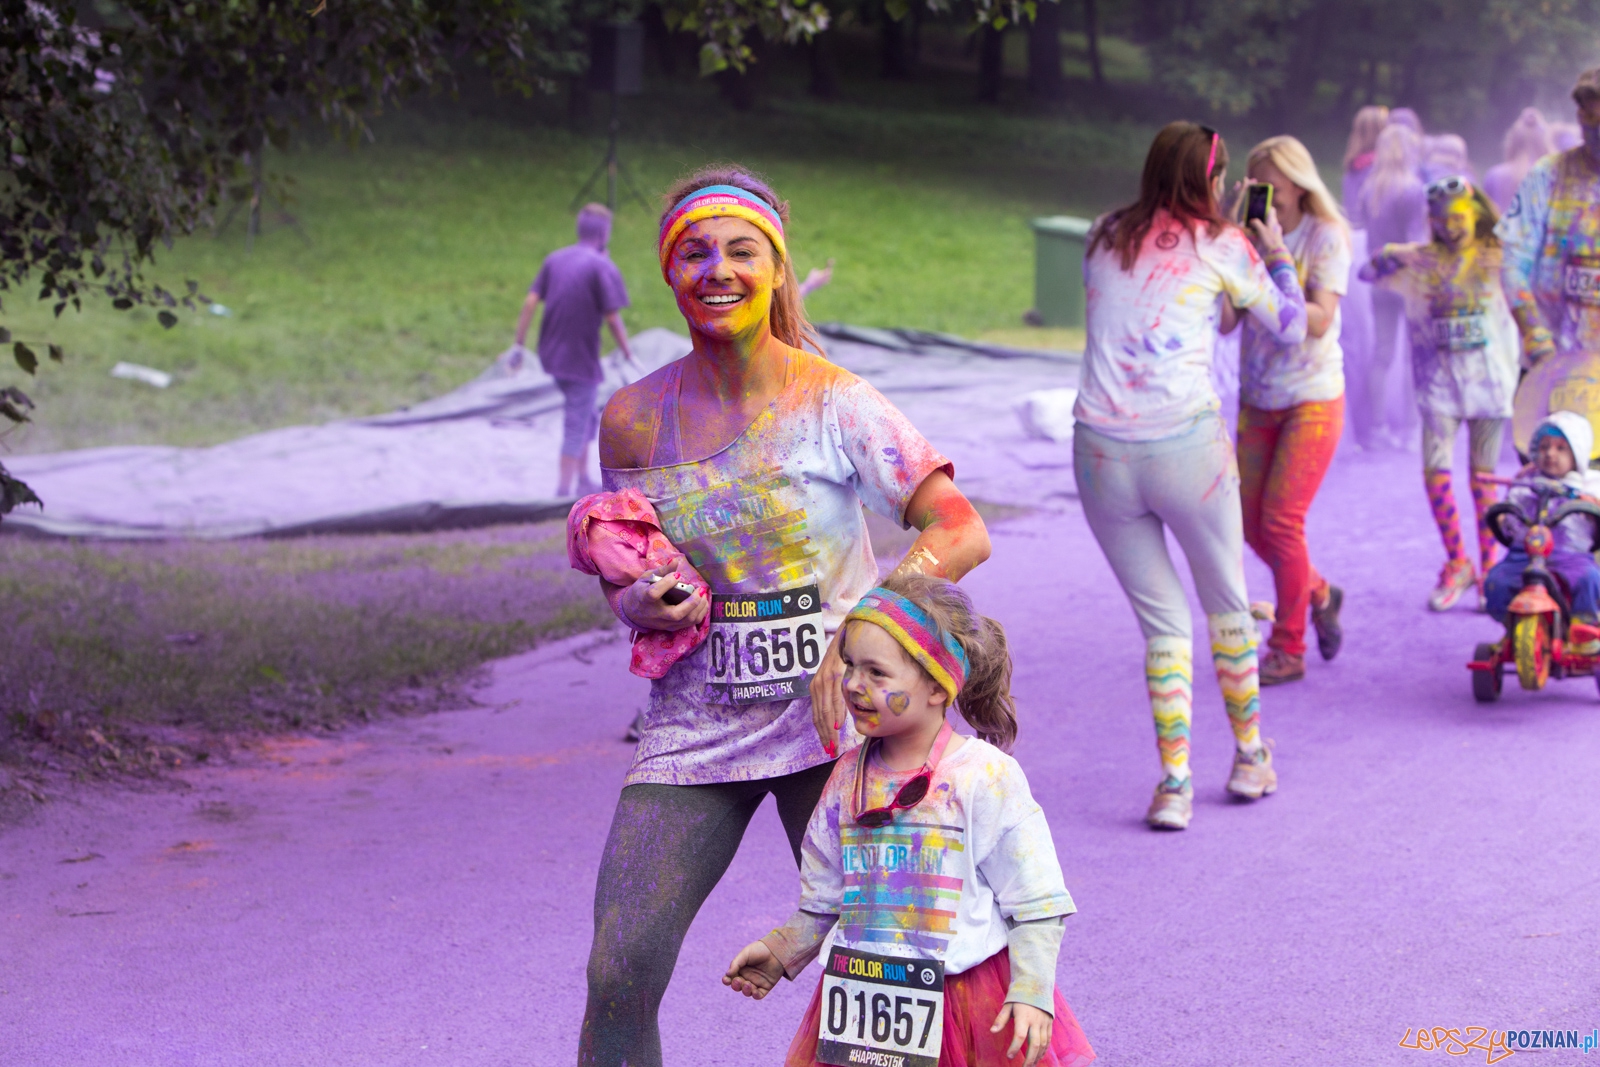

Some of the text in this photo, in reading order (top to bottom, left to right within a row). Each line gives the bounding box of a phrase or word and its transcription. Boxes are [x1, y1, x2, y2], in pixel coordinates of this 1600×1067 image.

[711, 197, 739, 205] RUNNER
[725, 601, 757, 618] COLOR
[711, 623, 820, 678] 01656
[833, 954, 849, 973] THE
[848, 957, 883, 979] COLOR
[827, 986, 936, 1049] 01657
